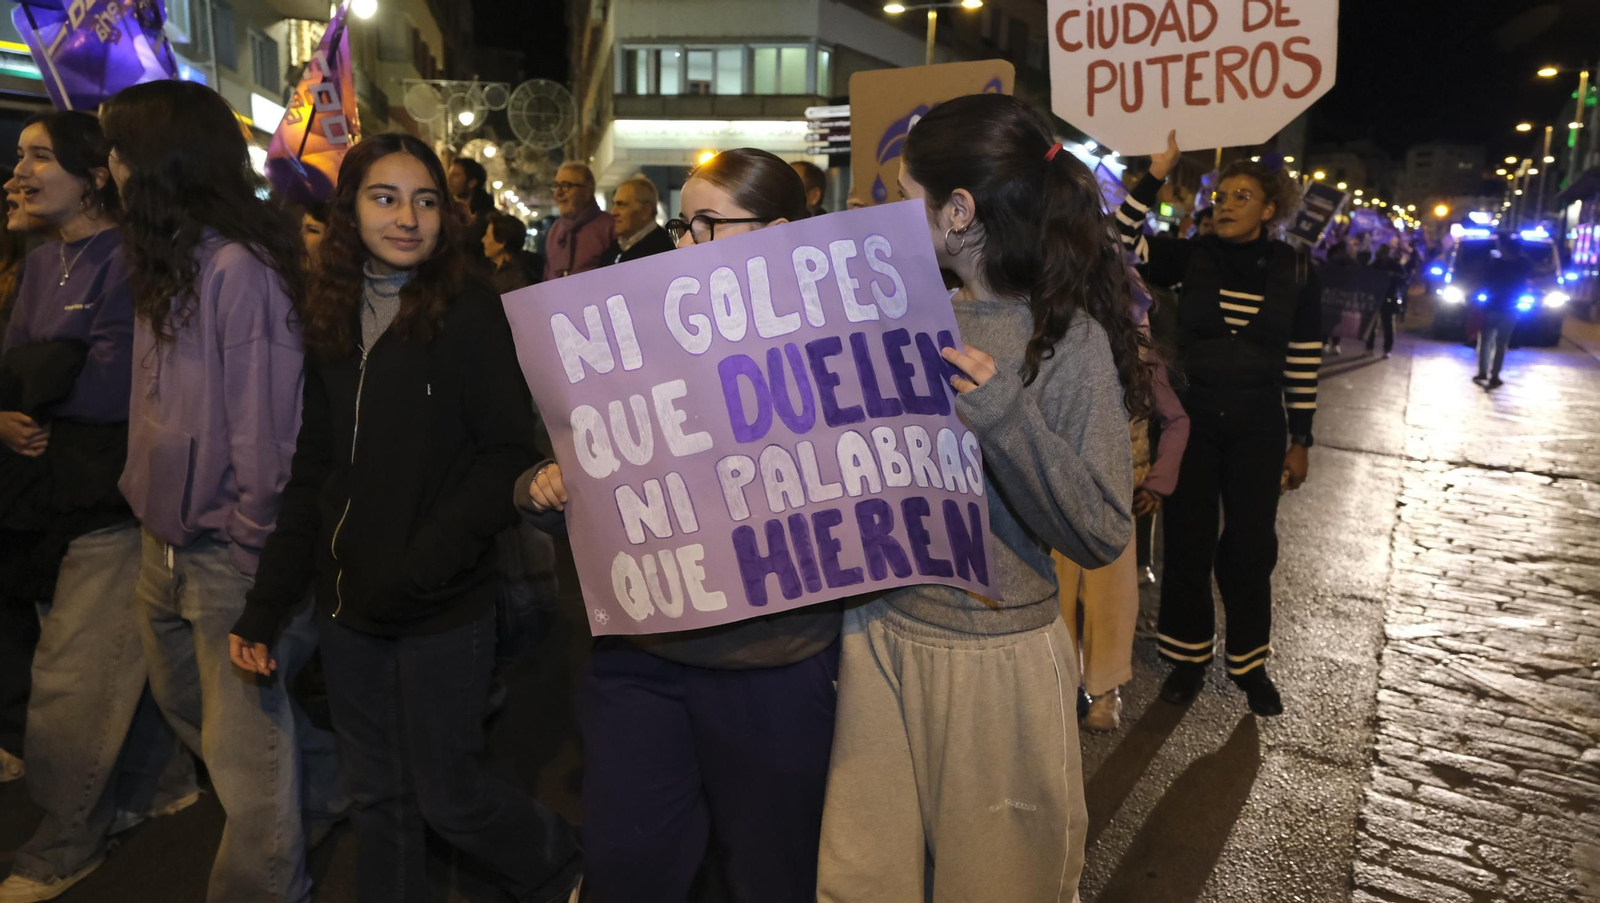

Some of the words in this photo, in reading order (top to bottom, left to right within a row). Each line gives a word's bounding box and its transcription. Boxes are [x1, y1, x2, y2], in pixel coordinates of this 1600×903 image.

[1087, 37, 1322, 117] PUTEROS
[1243, 0, 1300, 32] DE
[550, 294, 644, 384] NI
[663, 234, 908, 355] GOLPES
[570, 378, 714, 479] QUE
[717, 328, 966, 443] DUELEN
[614, 471, 699, 545] NI
[715, 425, 984, 522] PALABRAS
[611, 544, 727, 621] QUE
[731, 497, 989, 607] HIEREN
